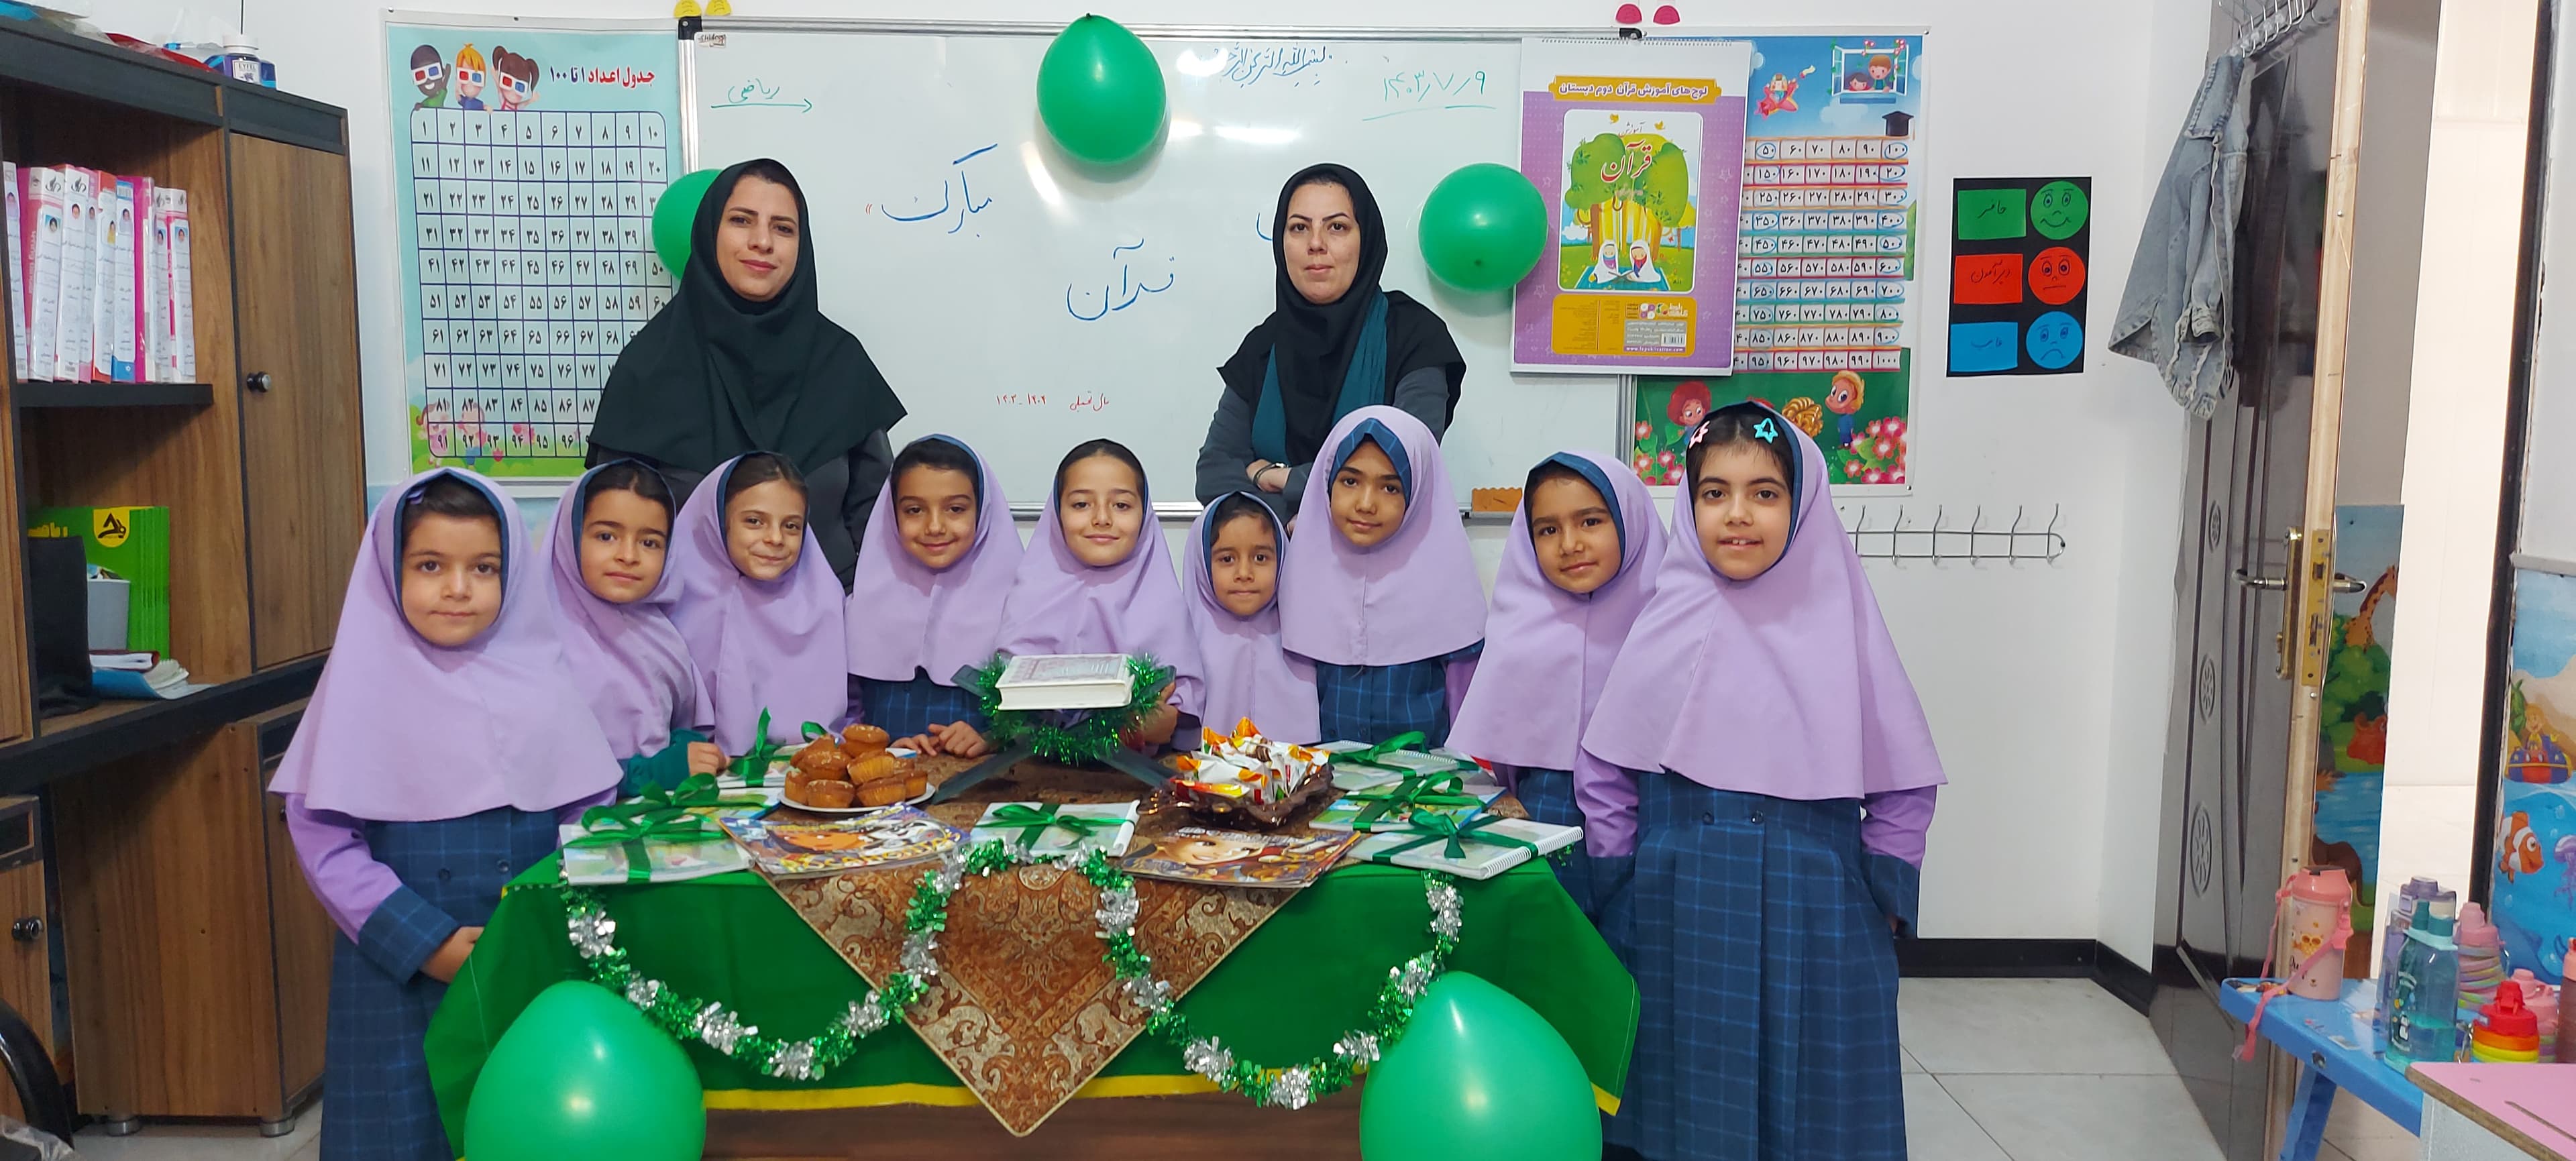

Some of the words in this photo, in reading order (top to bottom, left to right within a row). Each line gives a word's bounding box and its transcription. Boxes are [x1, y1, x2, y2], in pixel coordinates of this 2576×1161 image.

[550, 66, 567, 81] ۱۰۰
[570, 66, 579, 84] تا
[588, 66, 619, 84] اعداد
[622, 66, 655, 88] جدول
[1559, 83, 1593, 95] دبستان
[1595, 84, 1612, 95] دوم
[1616, 82, 1635, 95] قرآن
[1638, 82, 1670, 97] آموزش
[423, 121, 426, 136] ۱
[450, 122, 455, 137] ۲
[476, 123, 482, 138] ۳
[501, 124, 507, 139] ۴
[525, 125, 532, 140] ۵
[552, 125, 558, 140] ۶
[576, 125, 582, 140] ۷
[602, 125, 608, 140] ۸
[626, 125, 633, 140] ۹
[649, 125, 657, 140] ۱۰
[422, 156, 430, 172] ۱۱
[449, 158, 460, 173] ۱۲
[474, 158, 484, 174] ۱۳
[500, 160, 511, 174] ۱۴
[525, 160, 535, 175] ۱۵
[551, 160, 561, 176] ۱۶
[575, 161, 585, 176] ۱۷
[602, 161, 611, 175] ۱۸
[625, 160, 634, 176] ۱۹
[649, 161, 660, 176] ۲۰
[1601, 139, 1652, 182] قرآن
[881, 143, 998, 238] مبارک
[423, 192, 433, 209] ۲۱
[449, 193, 462, 208] ۲۲
[472, 193, 486, 209] ۲۳
[501, 195, 514, 209] ۲۴
[527, 195, 539, 211] ۲۵
[551, 195, 563, 211] ۲۶
[575, 195, 587, 211] ۲۷
[601, 195, 612, 211] ۲۸
[625, 195, 636, 211] ۲۹
[426, 227, 439, 243] ۳۱
[449, 227, 463, 243] ۳۲
[474, 228, 489, 243] ۳۳
[501, 229, 515, 244] ۳۴
[527, 230, 539, 244] ۳۵
[551, 229, 564, 245] ۳۶
[576, 229, 589, 245] ۳۷
[602, 229, 614, 245] ۳۸
[625, 229, 637, 245] ۳۹
[429, 258, 440, 274] ۴۱
[450, 258, 464, 274] ۴۲
[476, 259, 490, 274] ۴۳
[502, 260, 515, 274] ۴۴
[527, 260, 539, 275] ۴۵
[551, 260, 564, 275] ۴۶
[576, 260, 590, 275] ۴۷
[602, 260, 614, 275] ۴۸
[625, 260, 637, 275] ۴۹
[652, 262, 663, 276] ۵۰
[430, 294, 441, 309] ۵۱
[455, 293, 466, 309] ۵۲
[478, 294, 490, 309] ۵۳
[504, 294, 517, 309] ۵۴
[530, 295, 542, 309] ۵۵
[554, 295, 567, 310] ۵۶
[579, 295, 590, 310] ۵۷
[605, 295, 618, 310] ۵۸
[629, 295, 641, 311] ۵۹
[433, 329, 443, 343] ۶۱
[457, 329, 468, 343] ۶۲
[480, 329, 493, 343] ۶۳
[504, 329, 517, 345] ۶۴
[528, 330, 541, 345] ۶۵
[556, 330, 570, 345] ۶۶
[580, 330, 593, 345] ۶۷
[606, 330, 619, 345] ۶۸
[434, 363, 445, 378] ۷۱
[458, 362, 472, 378] ۷۲
[482, 363, 496, 378] ۷۳
[506, 363, 520, 378] ۷۴
[531, 364, 544, 378] ۷۵
[557, 364, 572, 378] ۷۶
[582, 364, 595, 378] ۷۷
[485, 398, 498, 412] ۸۳
[511, 398, 523, 412] ۸۴
[534, 398, 547, 412] ۸۵
[559, 398, 572, 413] ۸۶
[583, 398, 595, 413] ۸۷
